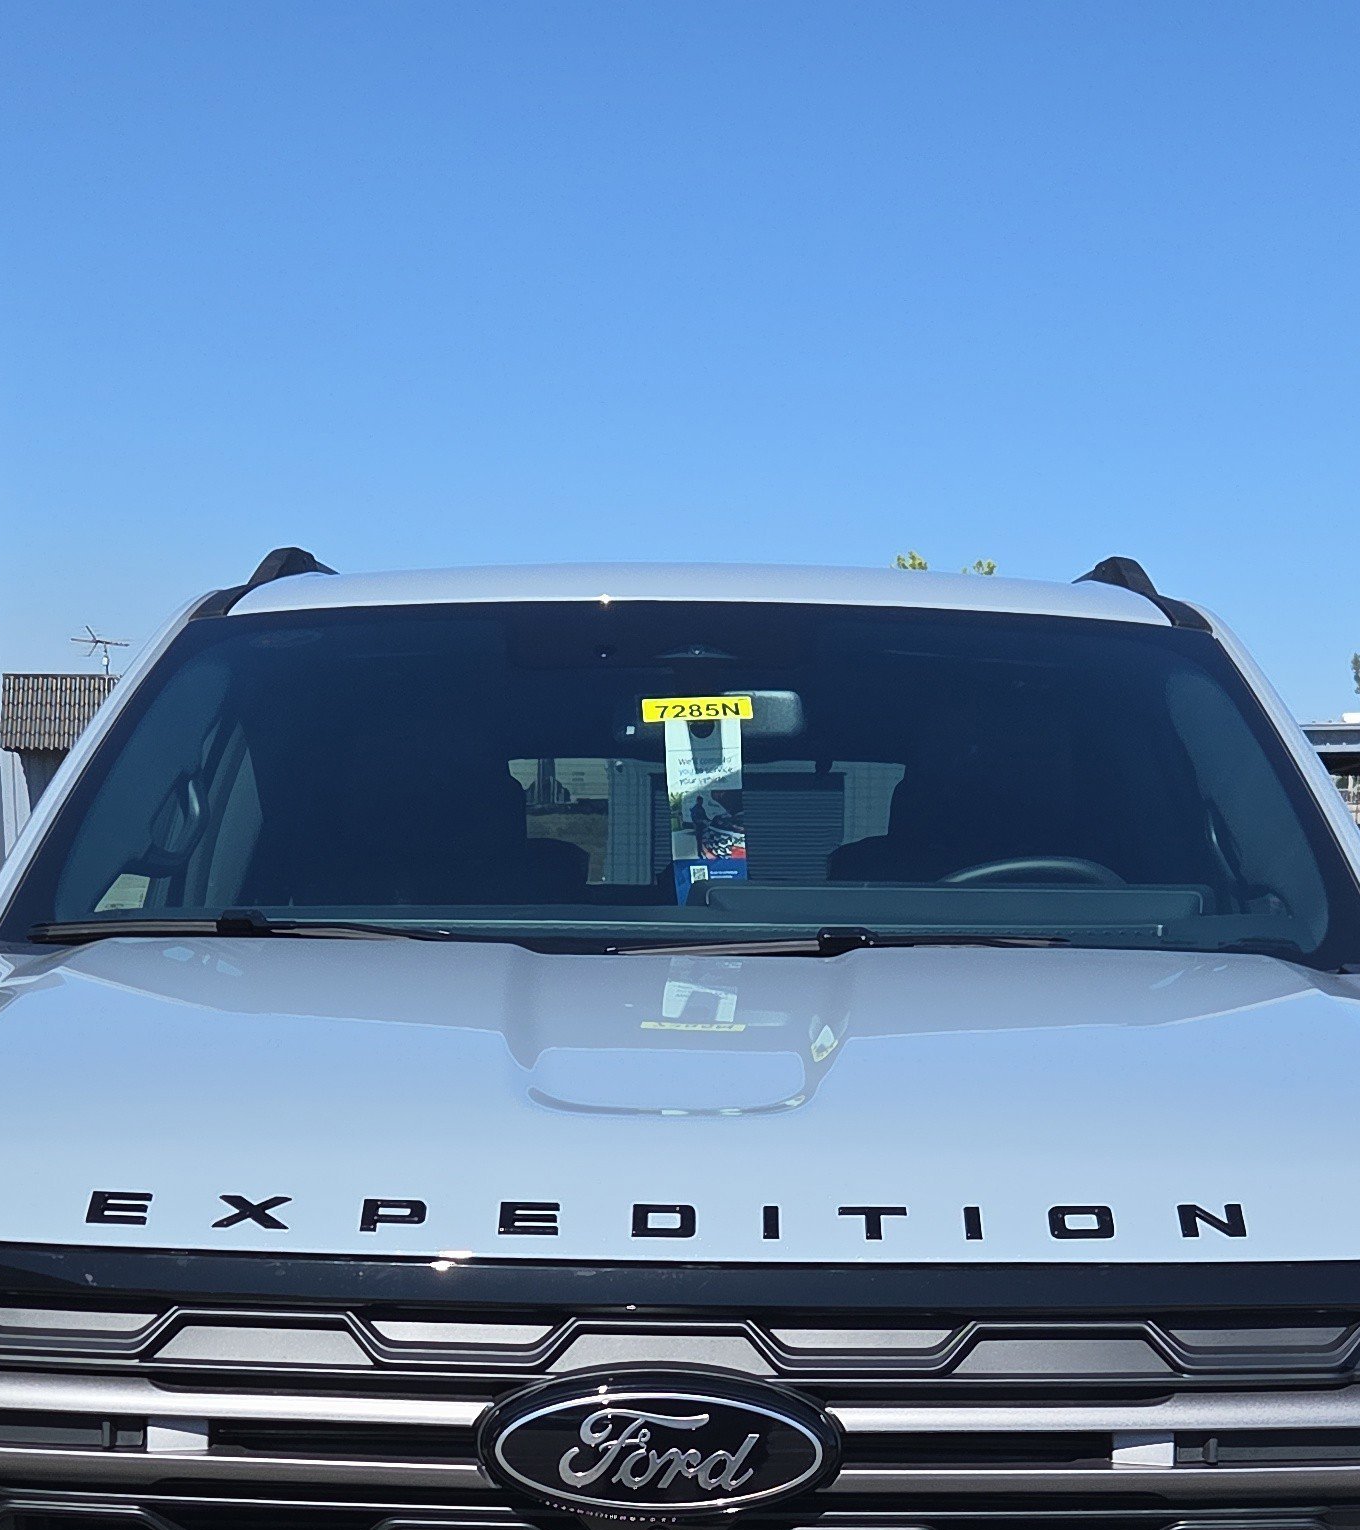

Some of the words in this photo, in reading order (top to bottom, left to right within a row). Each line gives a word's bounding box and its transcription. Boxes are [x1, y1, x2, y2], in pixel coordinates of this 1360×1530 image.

[655, 702, 740, 719] 7285N
[84, 1190, 1247, 1240] EXPEDITION
[558, 1408, 760, 1490] Ford
